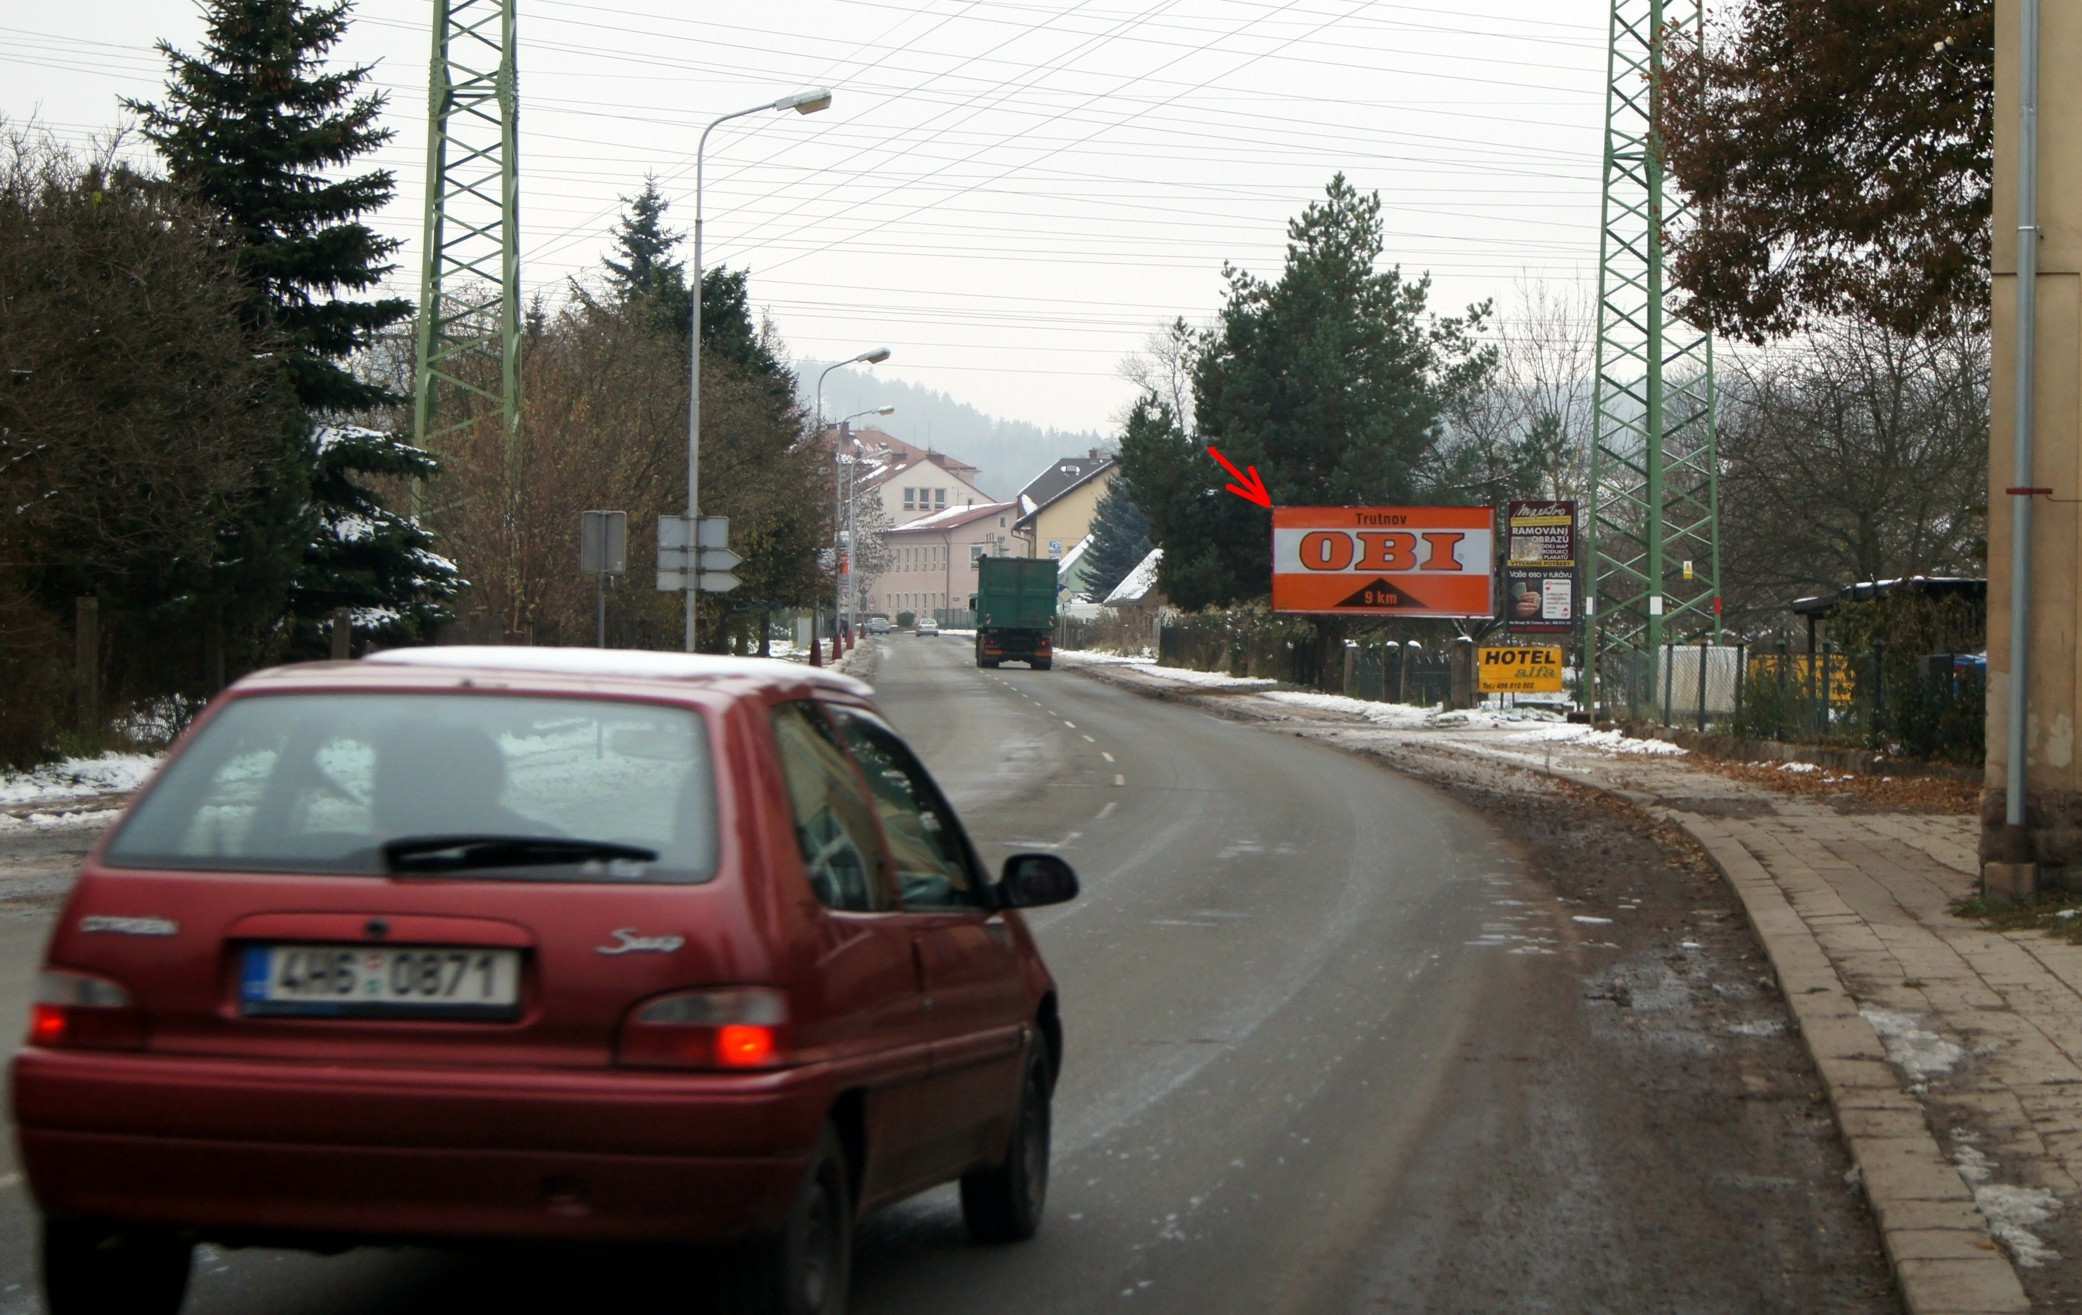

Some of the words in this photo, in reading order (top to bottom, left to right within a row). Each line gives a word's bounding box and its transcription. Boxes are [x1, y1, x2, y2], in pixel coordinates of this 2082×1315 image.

[1355, 513, 1407, 525] Trutnov
[1299, 531, 1465, 571] OBI
[1364, 591, 1373, 604] 9
[1376, 591, 1398, 605] km
[1485, 650, 1556, 665] HOTEL
[391, 952, 497, 998] 0871
